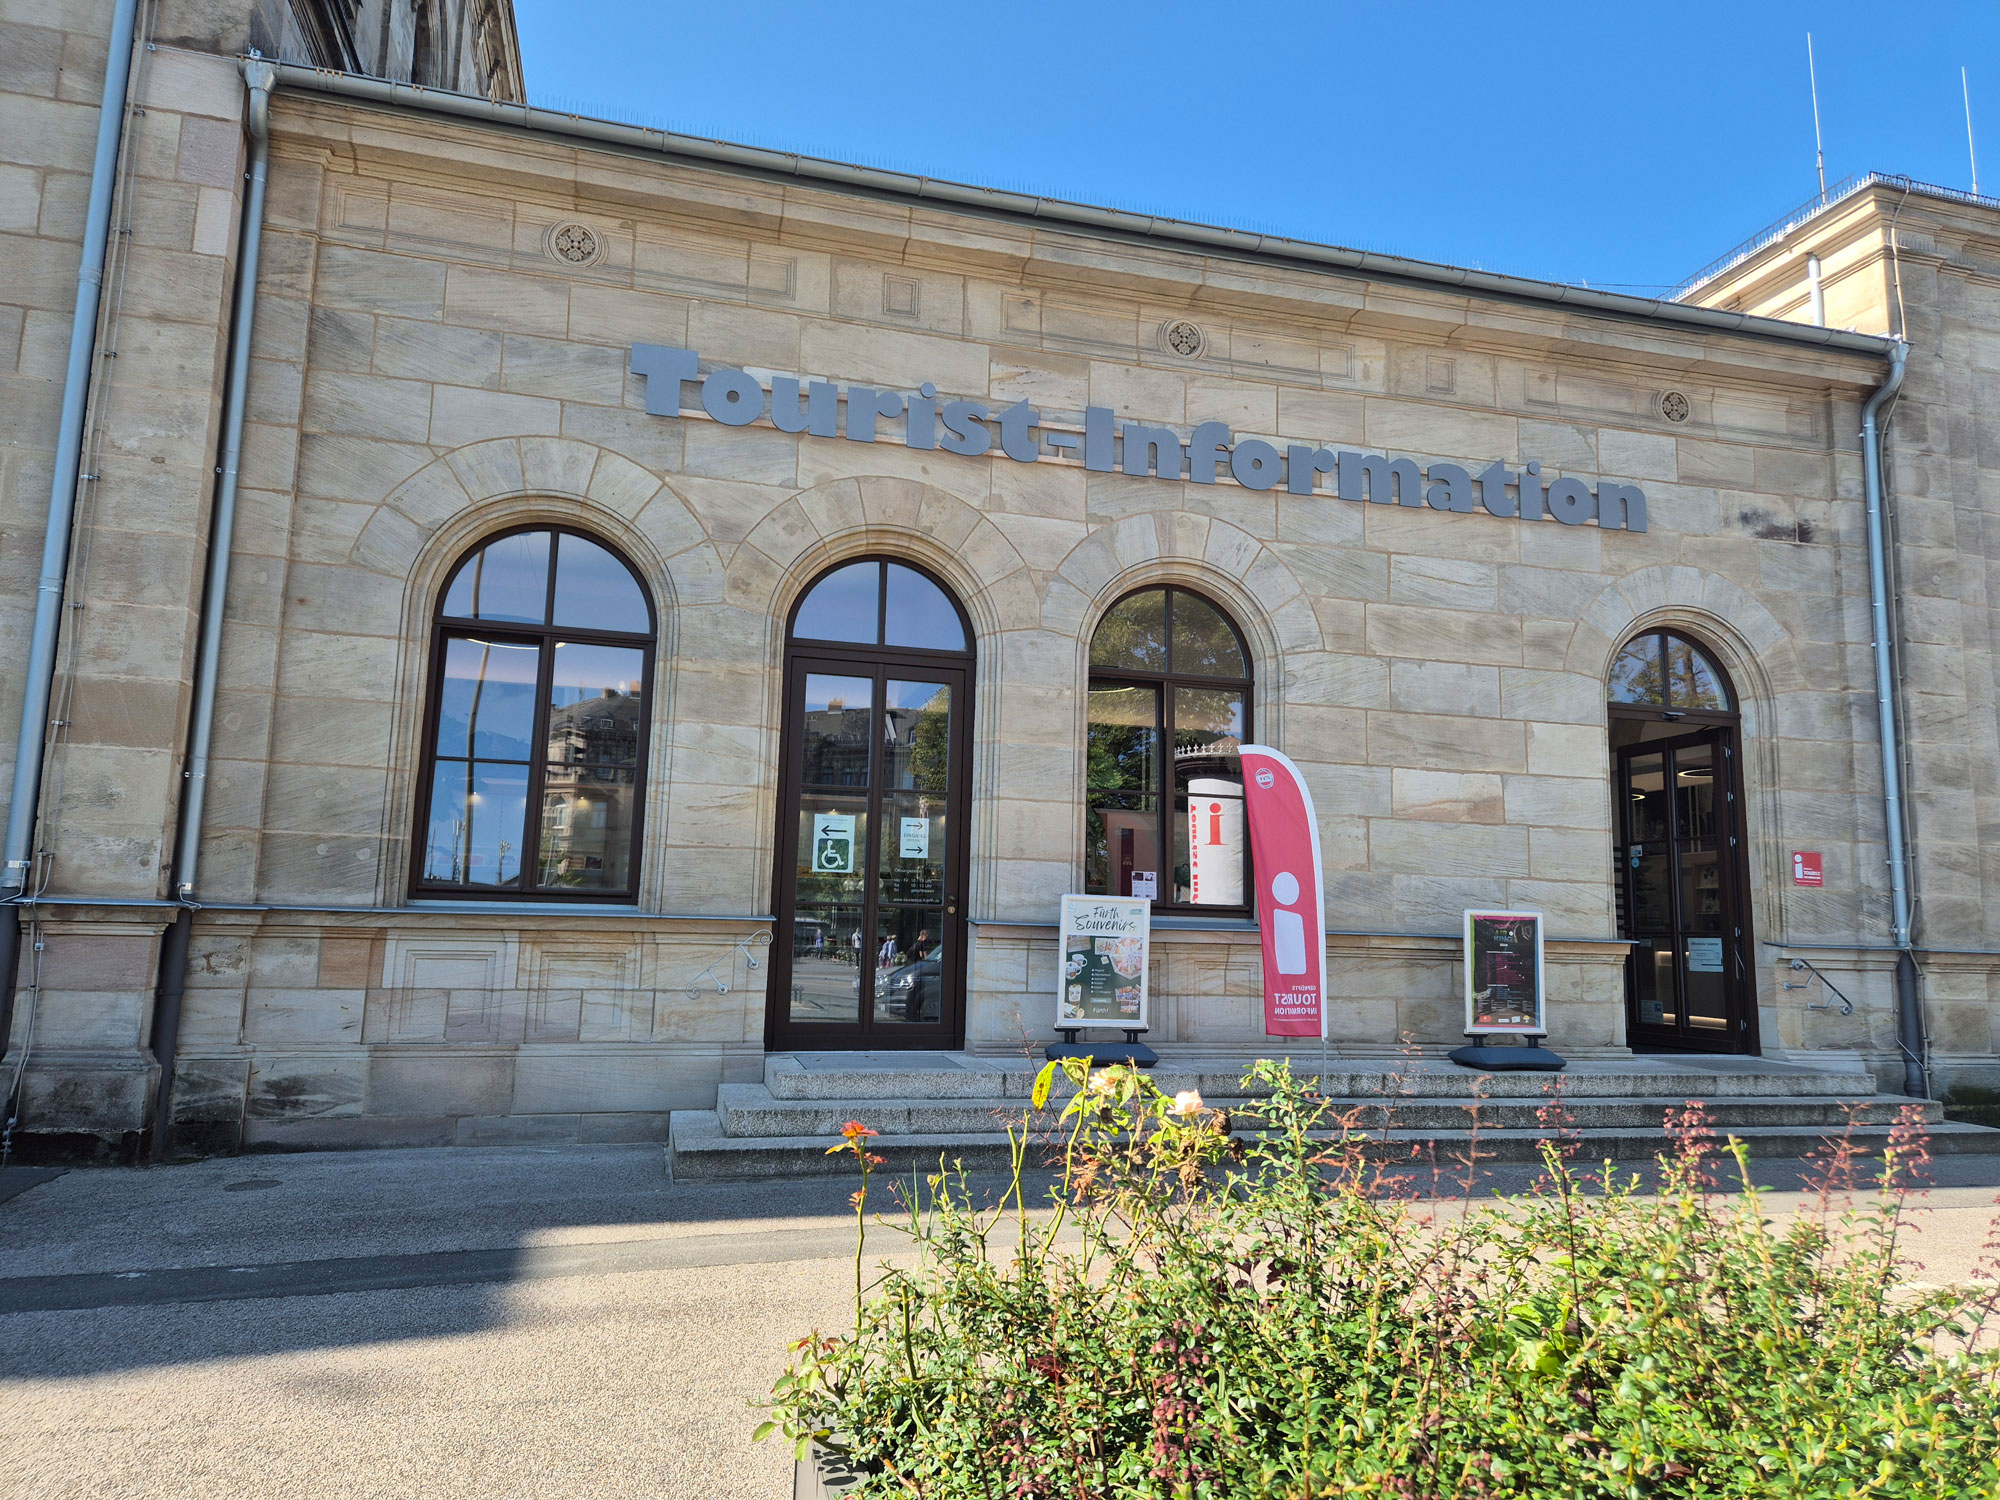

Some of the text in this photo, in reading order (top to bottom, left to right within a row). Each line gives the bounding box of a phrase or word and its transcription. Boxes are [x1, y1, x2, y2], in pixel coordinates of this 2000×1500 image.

[631, 342, 1648, 534] Tourist-Information
[1093, 906, 1120, 919] Fürth
[1073, 914, 1136, 931] Souvenirs
